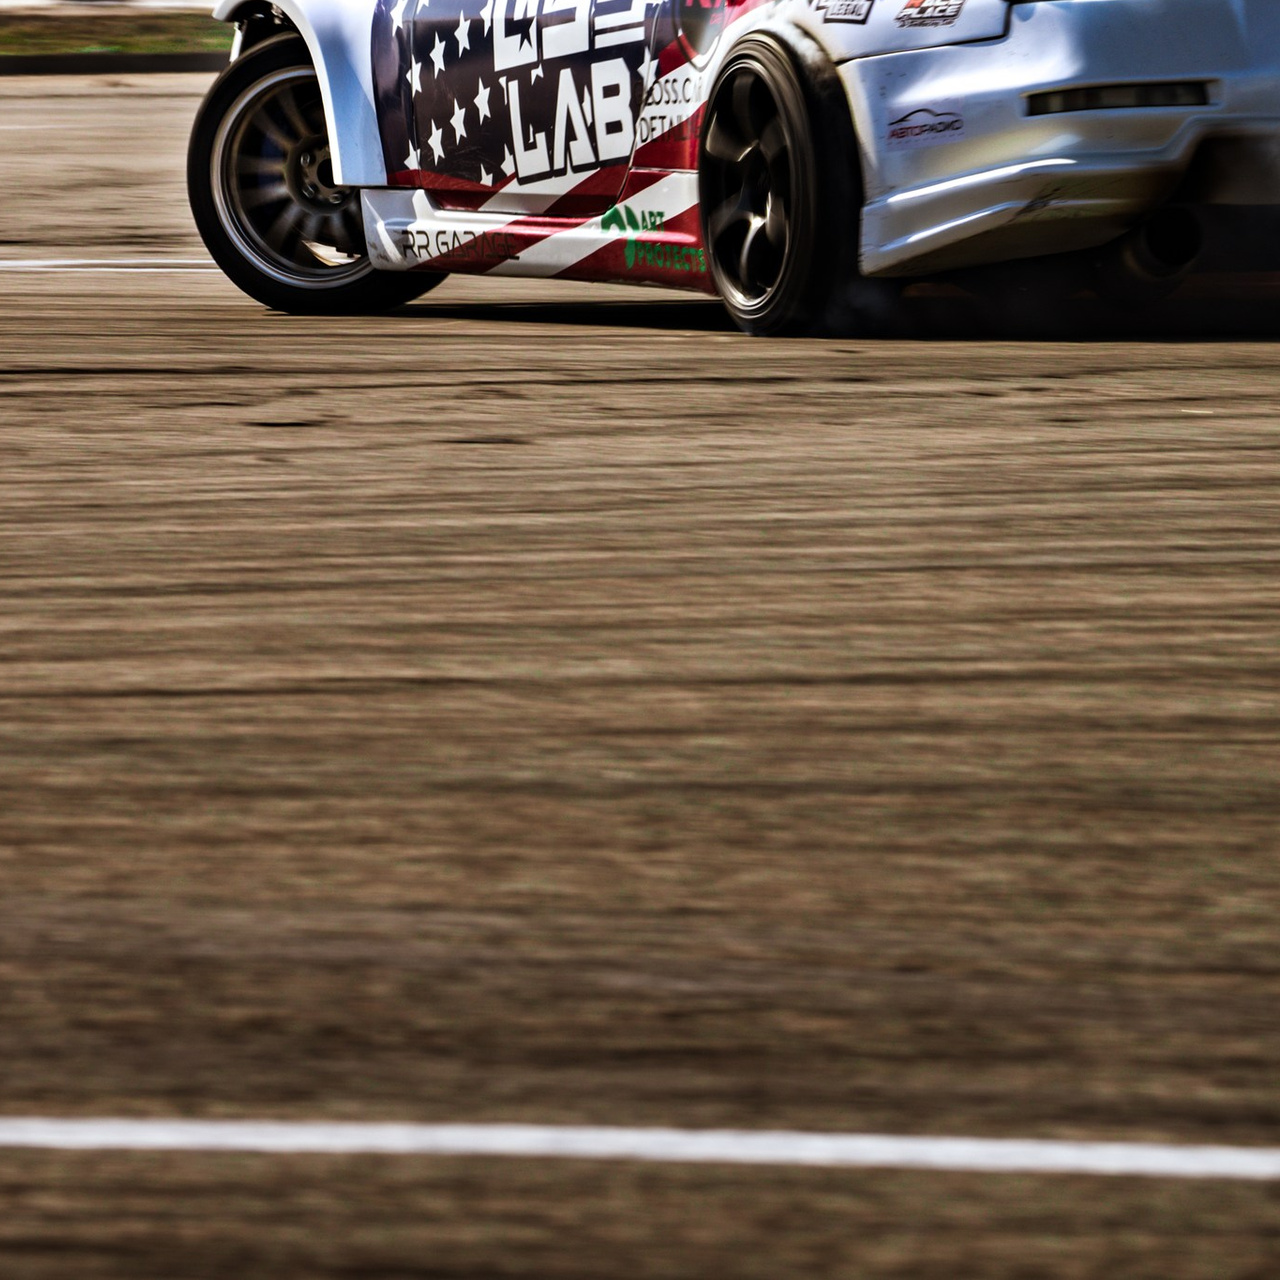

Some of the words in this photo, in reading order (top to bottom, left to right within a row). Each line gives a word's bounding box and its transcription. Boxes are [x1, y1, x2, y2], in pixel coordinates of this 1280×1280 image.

[897, 5, 963, 18] PLACE
[508, 57, 635, 179] LAB
[641, 210, 665, 232] ART
[436, 230, 520, 261] GARAGE
[635, 241, 706, 273] PROJECTS
